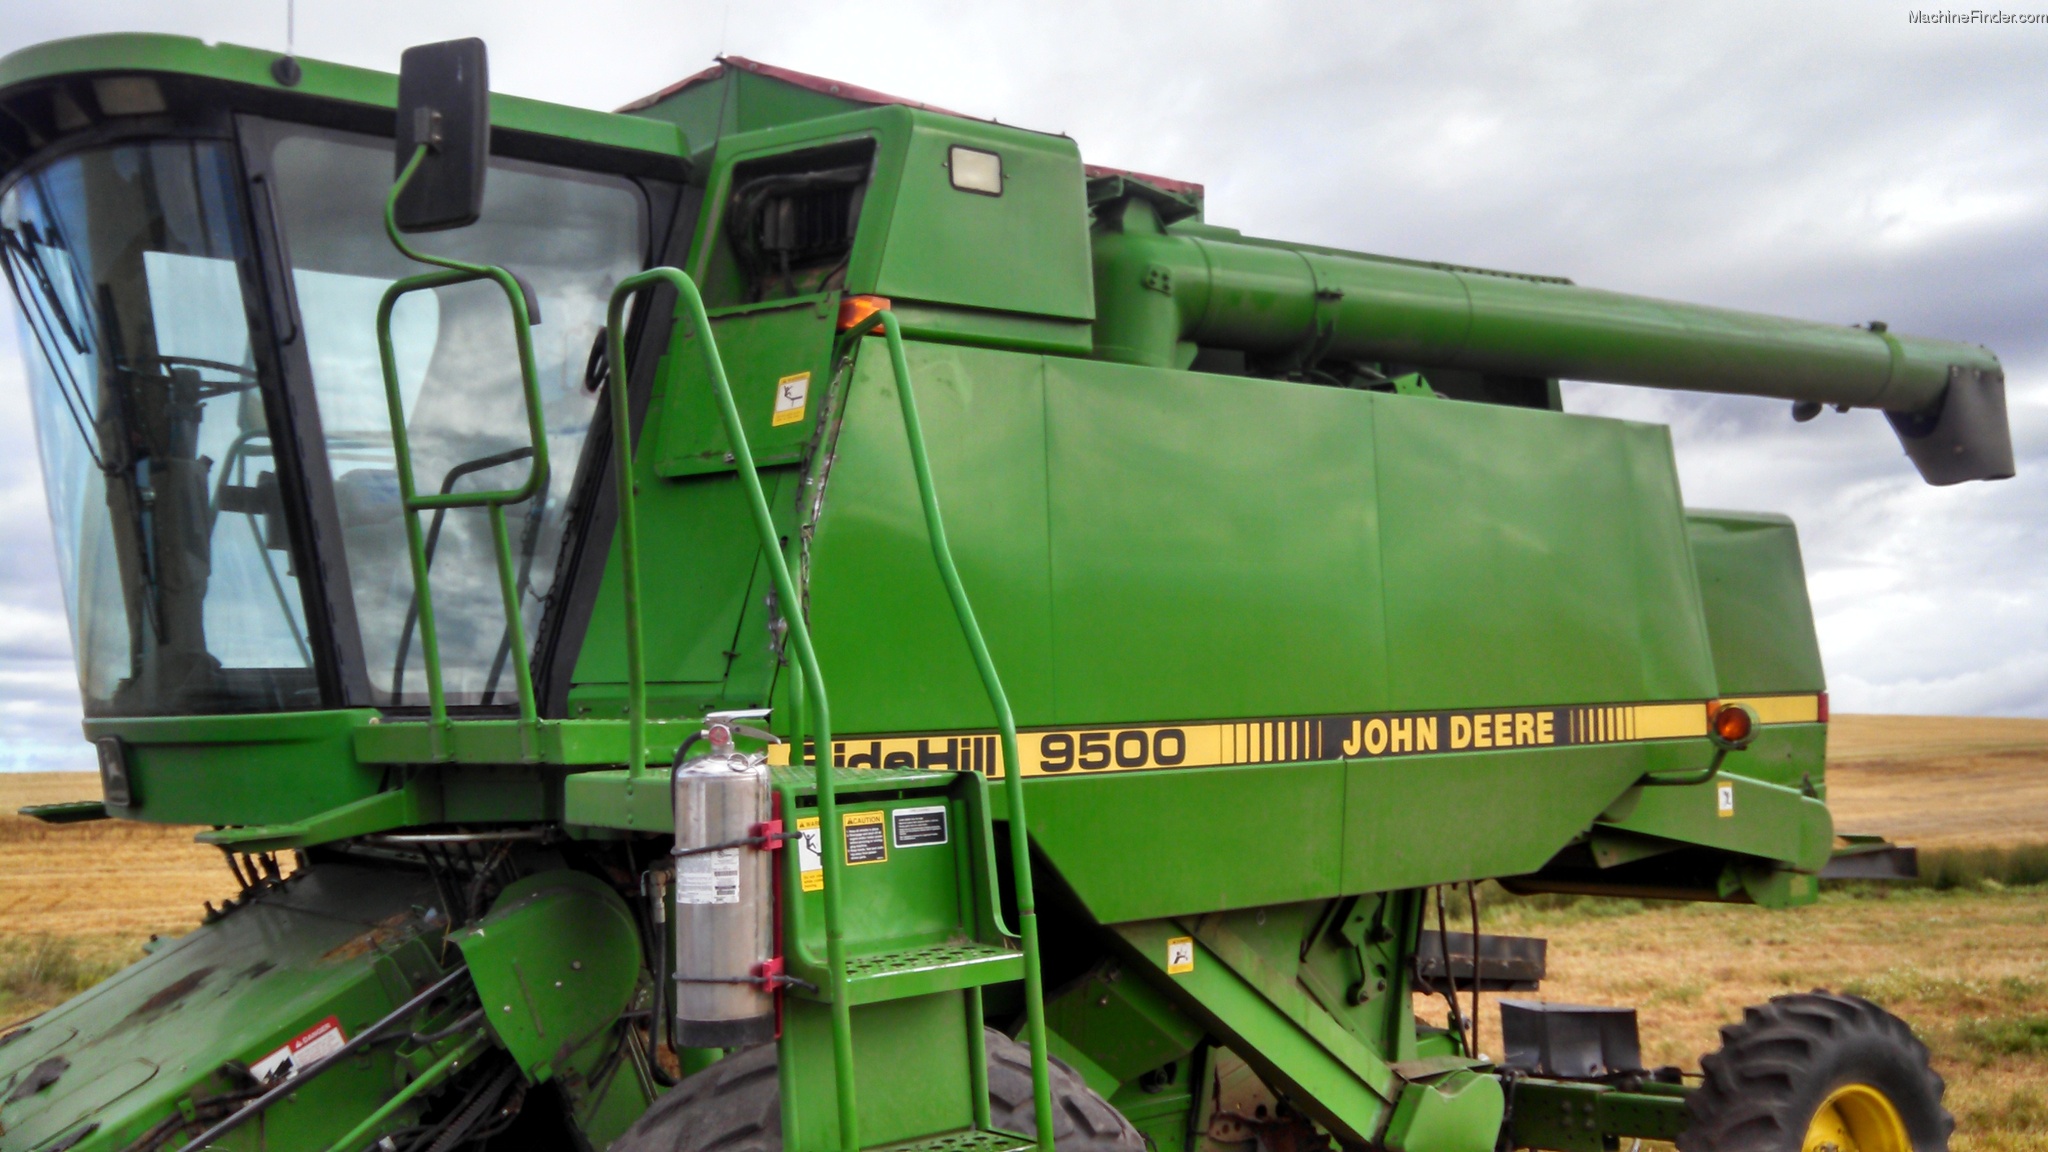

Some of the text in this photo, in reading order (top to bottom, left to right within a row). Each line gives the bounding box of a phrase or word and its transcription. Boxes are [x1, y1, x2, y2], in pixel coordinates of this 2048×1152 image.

[789, 728, 1186, 776] ideHill 9500
[1343, 711, 1554, 756] JOHN DEERE
[853, 816, 880, 824] CAUTION
